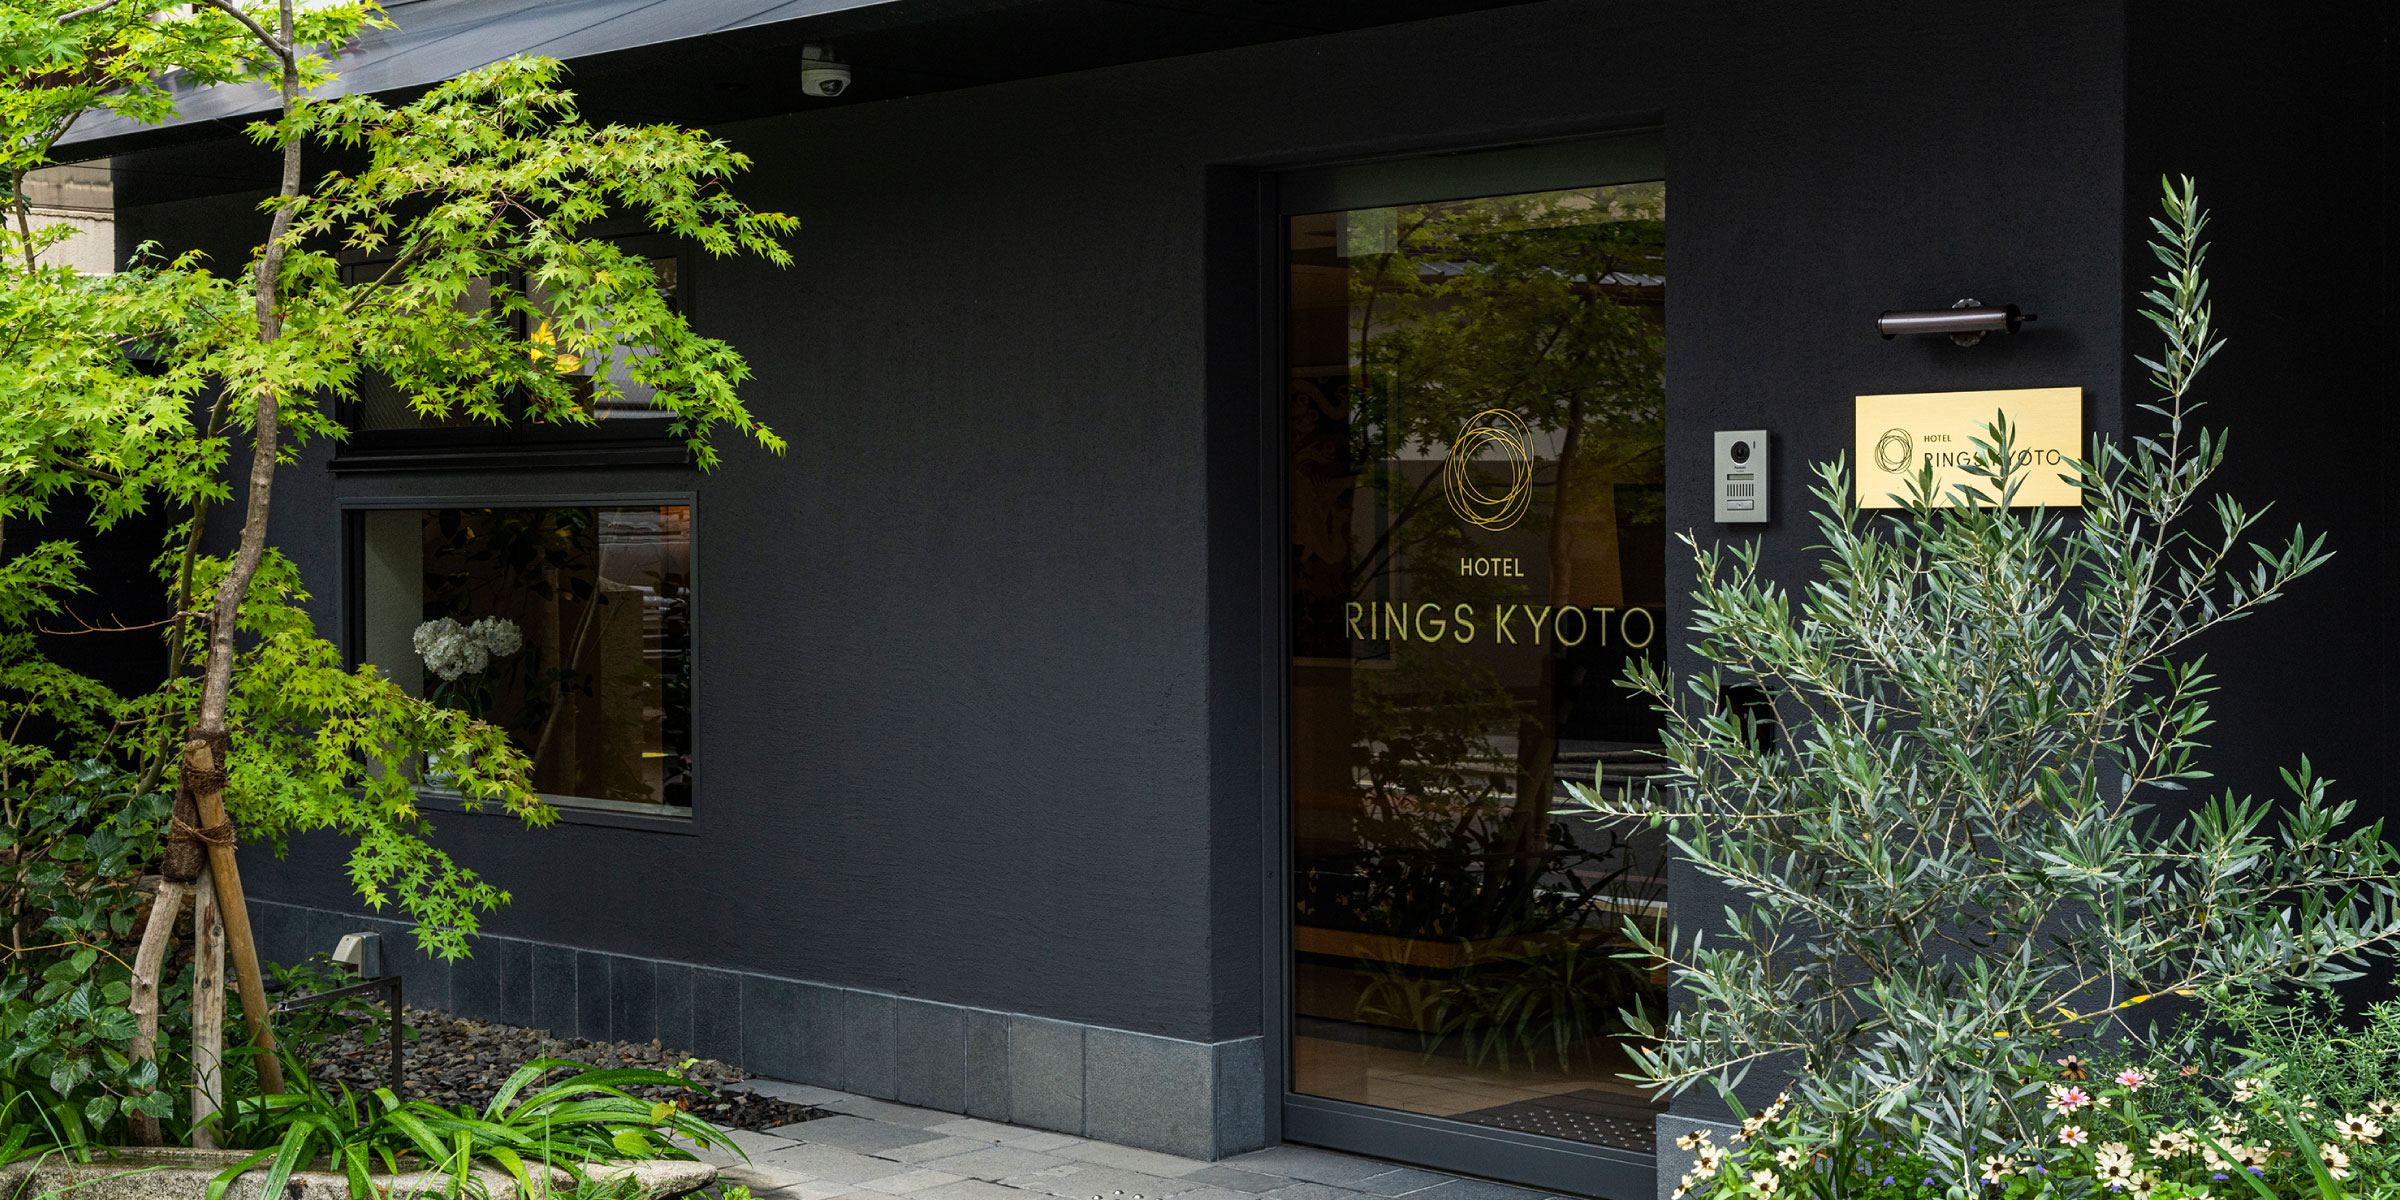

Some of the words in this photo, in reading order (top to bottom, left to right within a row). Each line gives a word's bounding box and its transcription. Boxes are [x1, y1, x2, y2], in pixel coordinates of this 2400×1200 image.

[1923, 434, 1952, 443] HOTEL
[1460, 557, 1525, 578] HOTEL
[1345, 601, 1476, 644] RINGS
[1495, 603, 1655, 648] KYOTO
